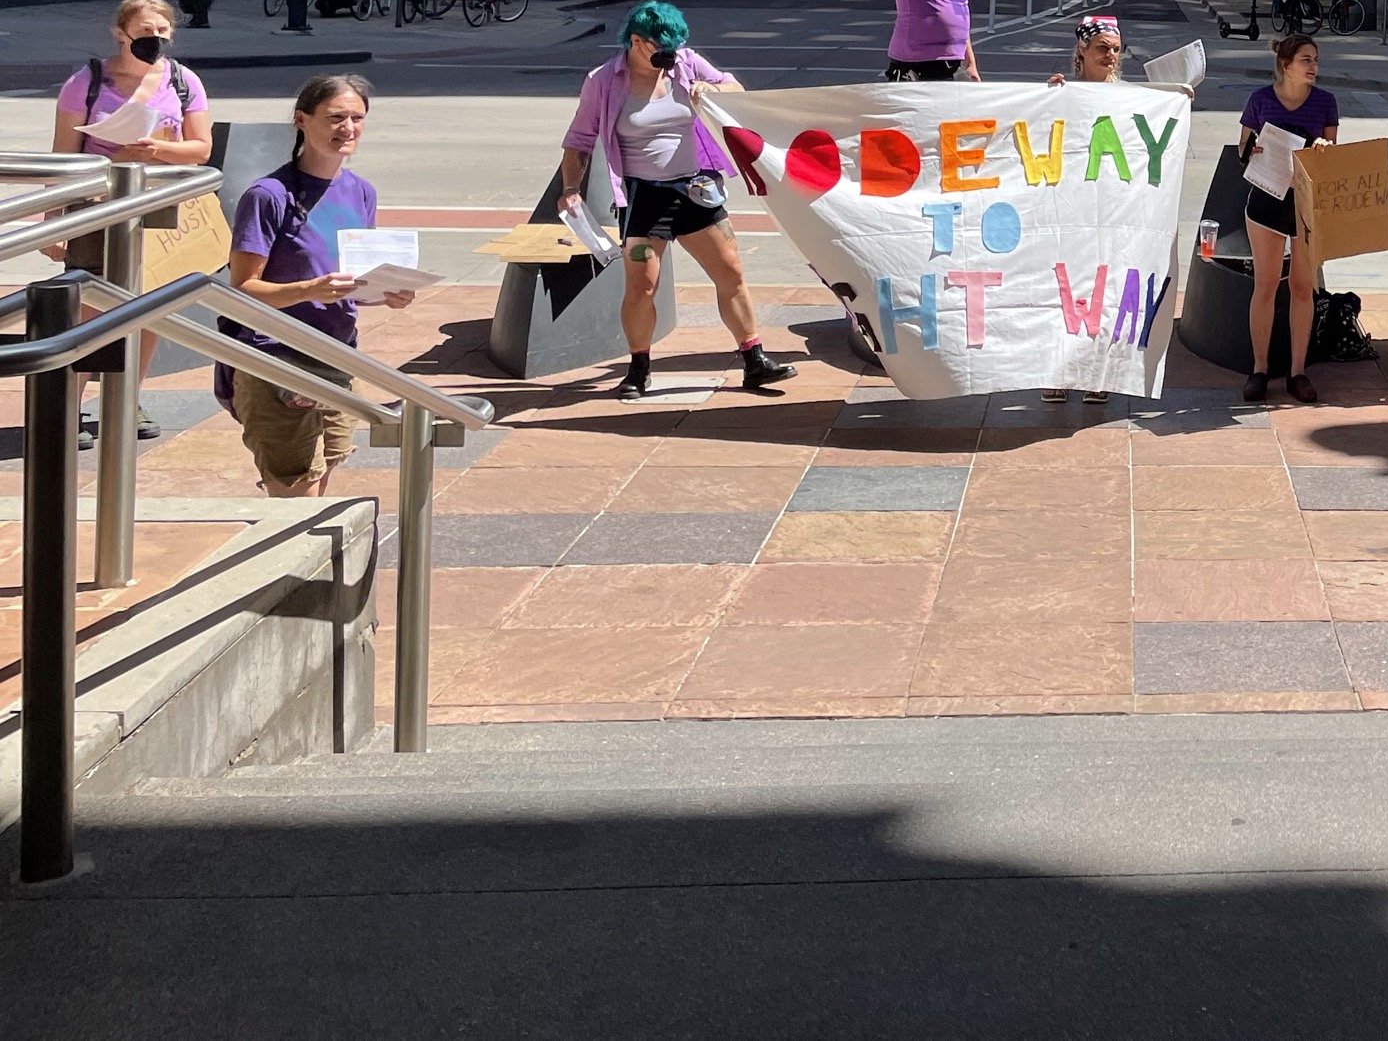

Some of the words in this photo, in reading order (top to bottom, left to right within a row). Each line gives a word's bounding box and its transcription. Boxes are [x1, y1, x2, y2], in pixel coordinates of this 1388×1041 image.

[722, 113, 1178, 198] RODEWAY
[1317, 178, 1348, 195] FOR
[1357, 172, 1383, 190] ALL
[921, 201, 1021, 257] TO
